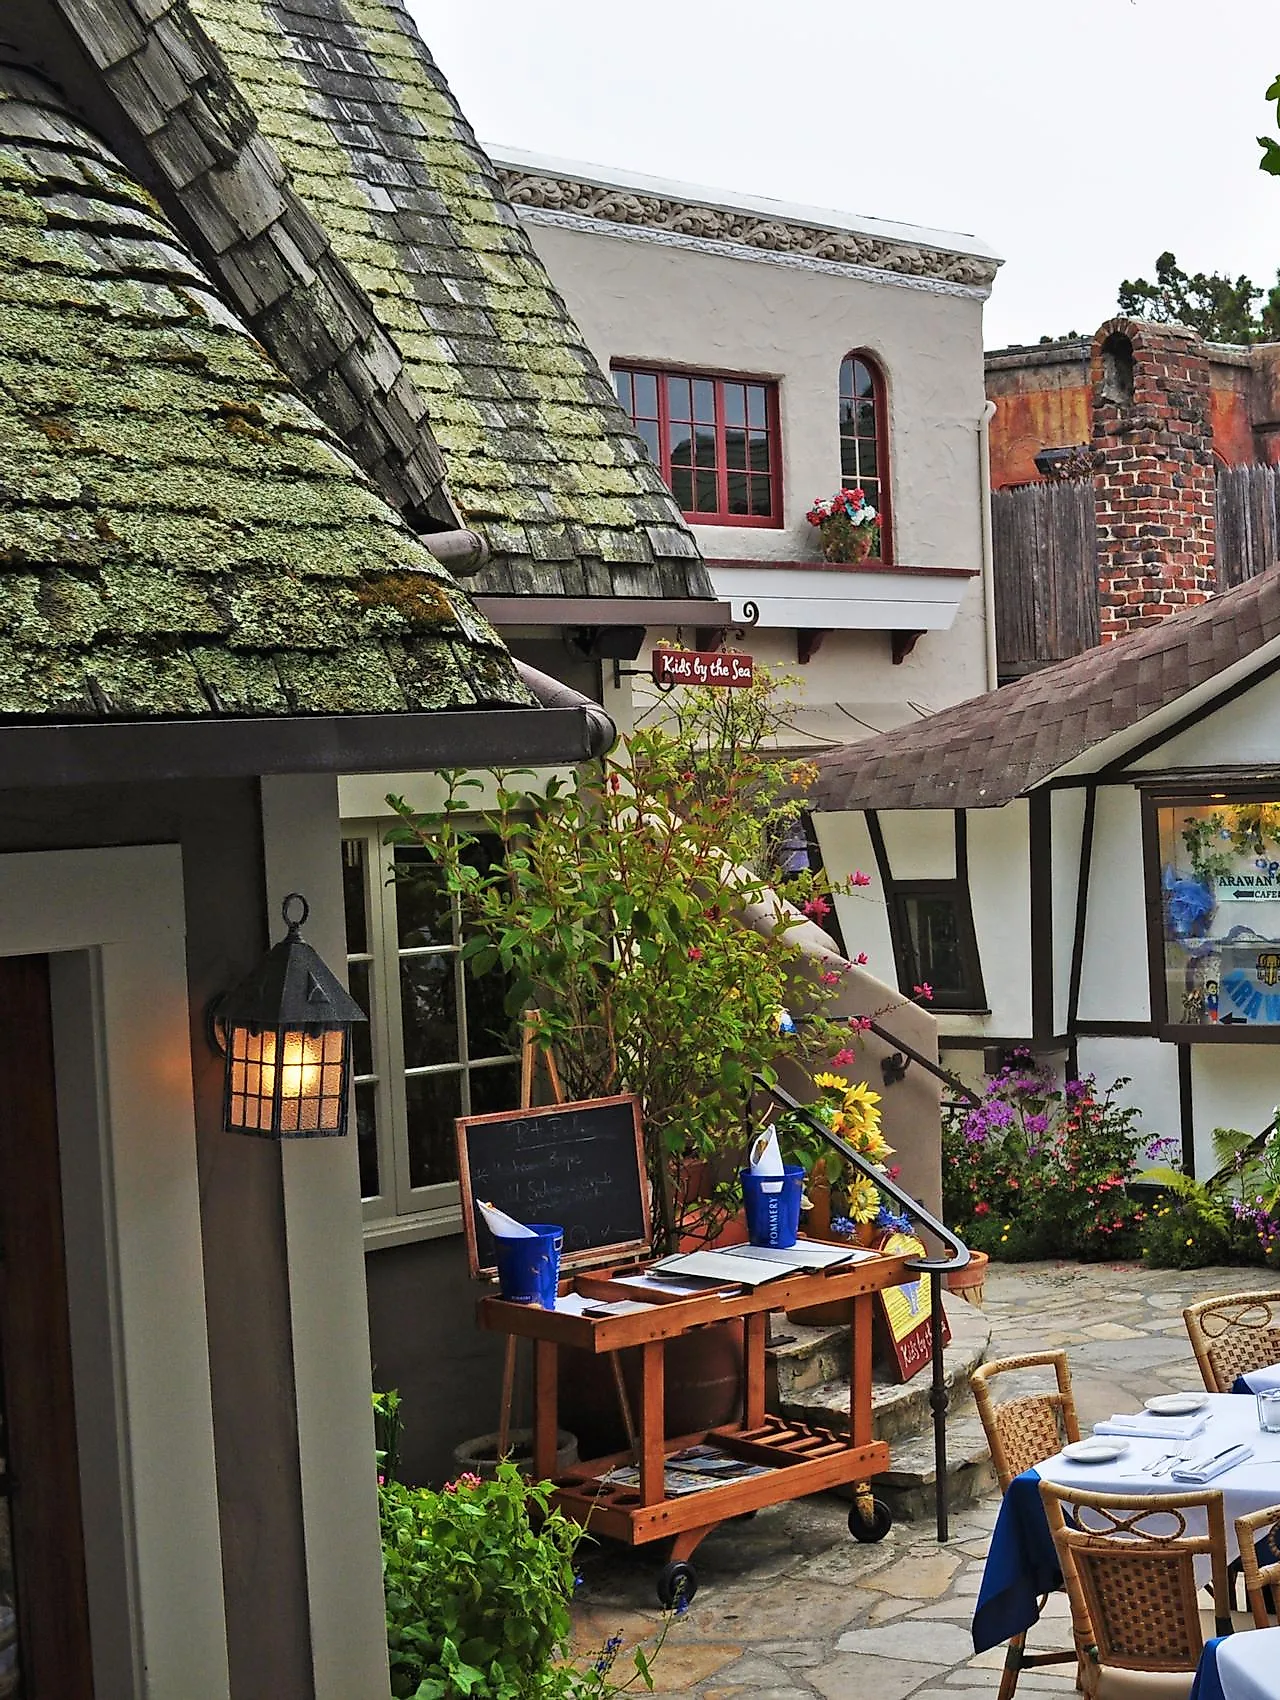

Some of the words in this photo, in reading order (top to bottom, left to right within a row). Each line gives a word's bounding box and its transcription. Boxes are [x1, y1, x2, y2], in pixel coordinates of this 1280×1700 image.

[662, 655, 691, 676] Kids
[694, 657, 708, 682] by
[710, 658, 729, 677] the
[732, 659, 751, 680] Sea
[1219, 875, 1273, 887] ARAWAN
[1254, 890, 1279, 899] CAFE
[768, 1196, 779, 1246] POMMERY
